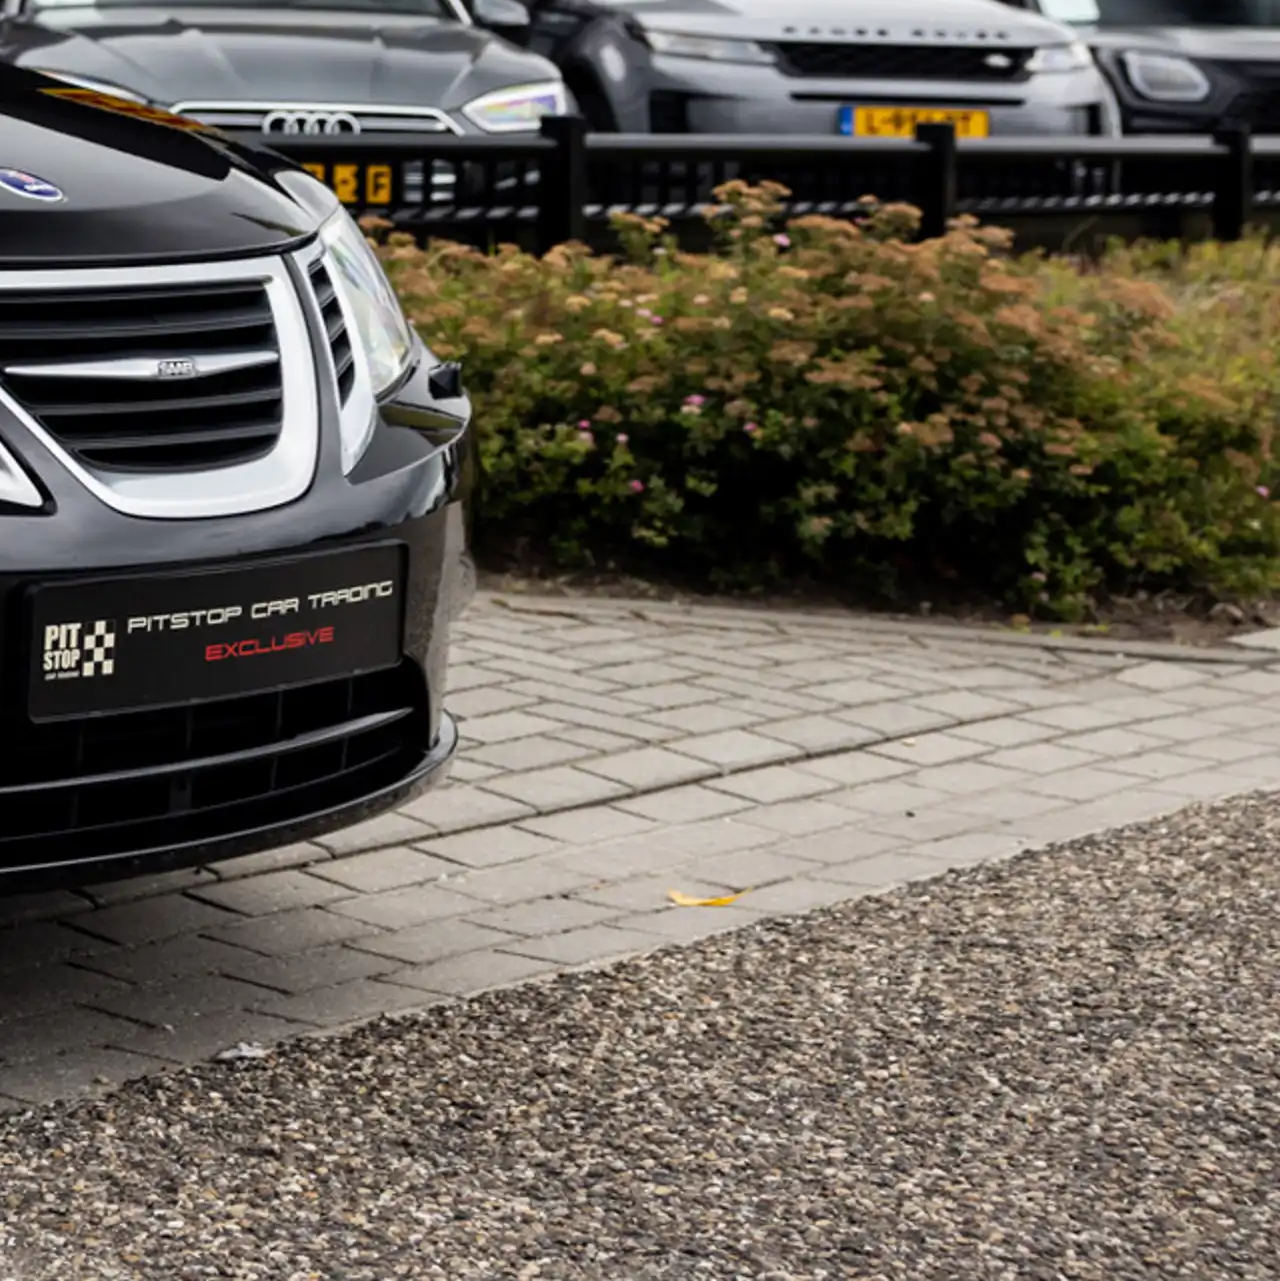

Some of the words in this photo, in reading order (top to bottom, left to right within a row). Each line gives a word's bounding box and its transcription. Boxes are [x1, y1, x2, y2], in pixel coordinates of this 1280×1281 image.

[127, 605, 244, 635] PITSTOP
[250, 596, 301, 621] CAR
[307, 580, 395, 610] TRADING
[43, 622, 83, 651] PIT
[204, 625, 336, 662] EXCLUSIVE
[42, 648, 82, 673] STOP
